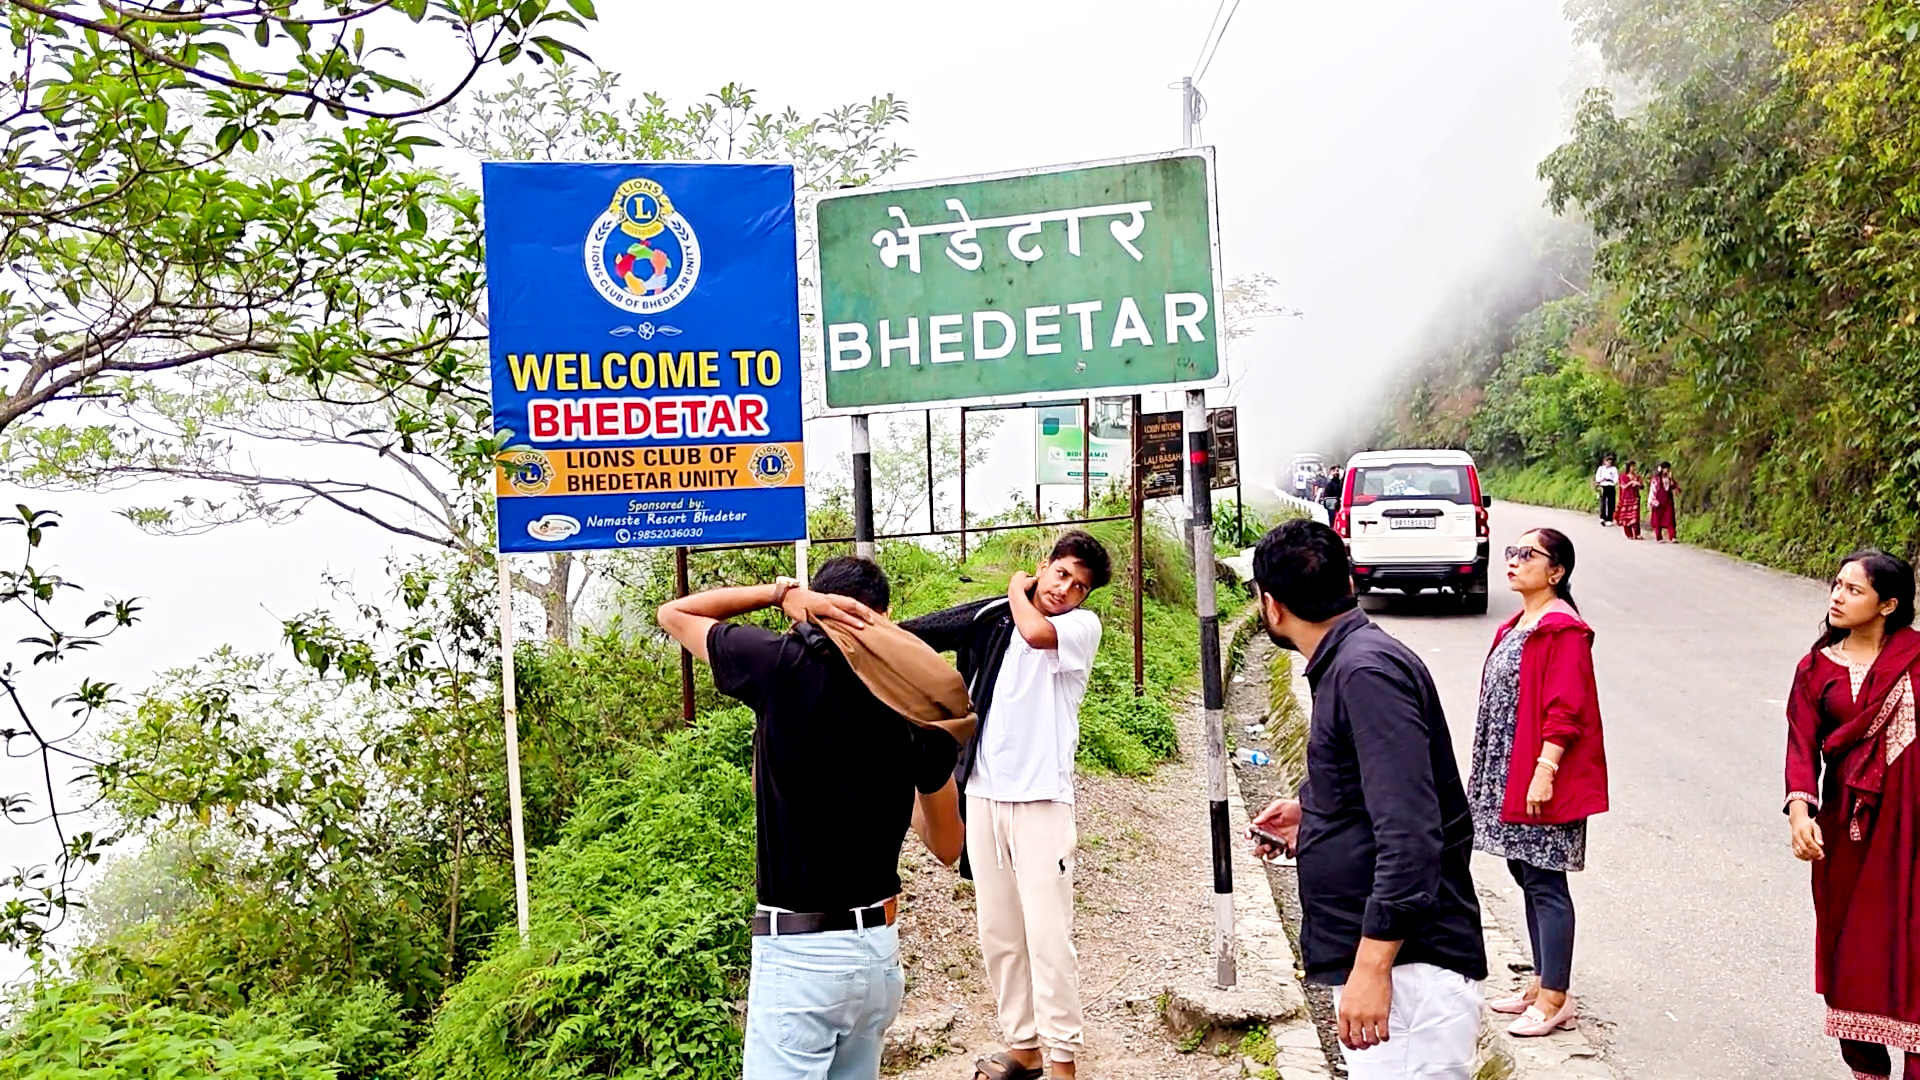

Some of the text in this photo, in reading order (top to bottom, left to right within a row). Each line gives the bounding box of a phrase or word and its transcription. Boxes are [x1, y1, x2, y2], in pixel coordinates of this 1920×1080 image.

[622, 181, 660, 194] LIONS
[634, 197, 652, 219] L
[872, 199, 1153, 274] भेडेटार
[592, 245, 695, 310] LIONS CLUB OF BHEDETAR UNITY
[828, 292, 1209, 372] BHEDETAR
[508, 350, 782, 392] WELCOME TO
[533, 399, 764, 437] BHEDETAR
[517, 454, 543, 463] LIONS
[567, 447, 737, 469] LIONS CLUB OF
[759, 446, 783, 456] LIONS
[526, 465, 538, 480] L
[766, 457, 778, 472] L
[567, 473, 671, 492] BHEDETAR
[679, 469, 738, 487] UNITY
[628, 499, 705, 512] Sponsored by:
[586, 510, 747, 527] Namaste Resort Bhedetar
